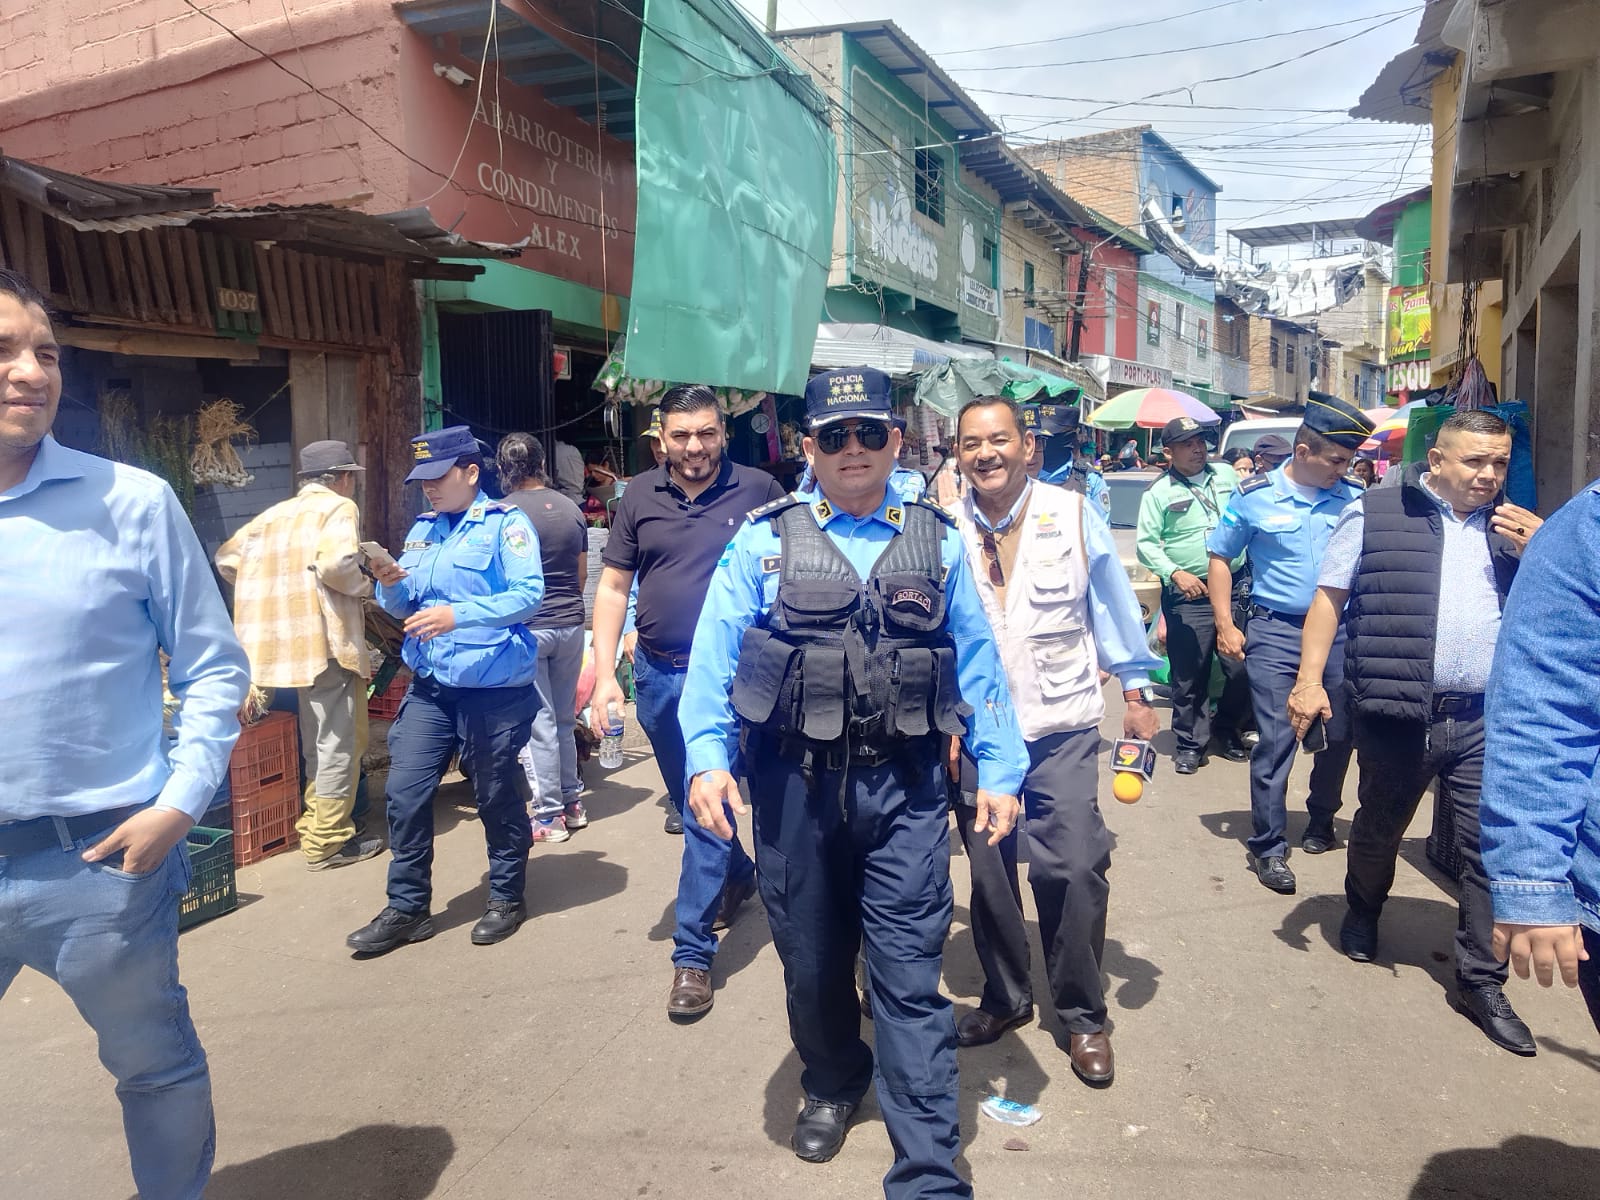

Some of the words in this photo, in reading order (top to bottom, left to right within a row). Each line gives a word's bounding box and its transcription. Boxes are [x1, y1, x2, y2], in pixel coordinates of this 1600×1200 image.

[544, 156, 559, 186] Y
[477, 162, 619, 240] CONDIMENTOS
[530, 222, 582, 261] ALEX
[220, 288, 256, 312] 1037
[829, 374, 865, 386] POLICIA
[826, 393, 871, 406] NACIONAL
